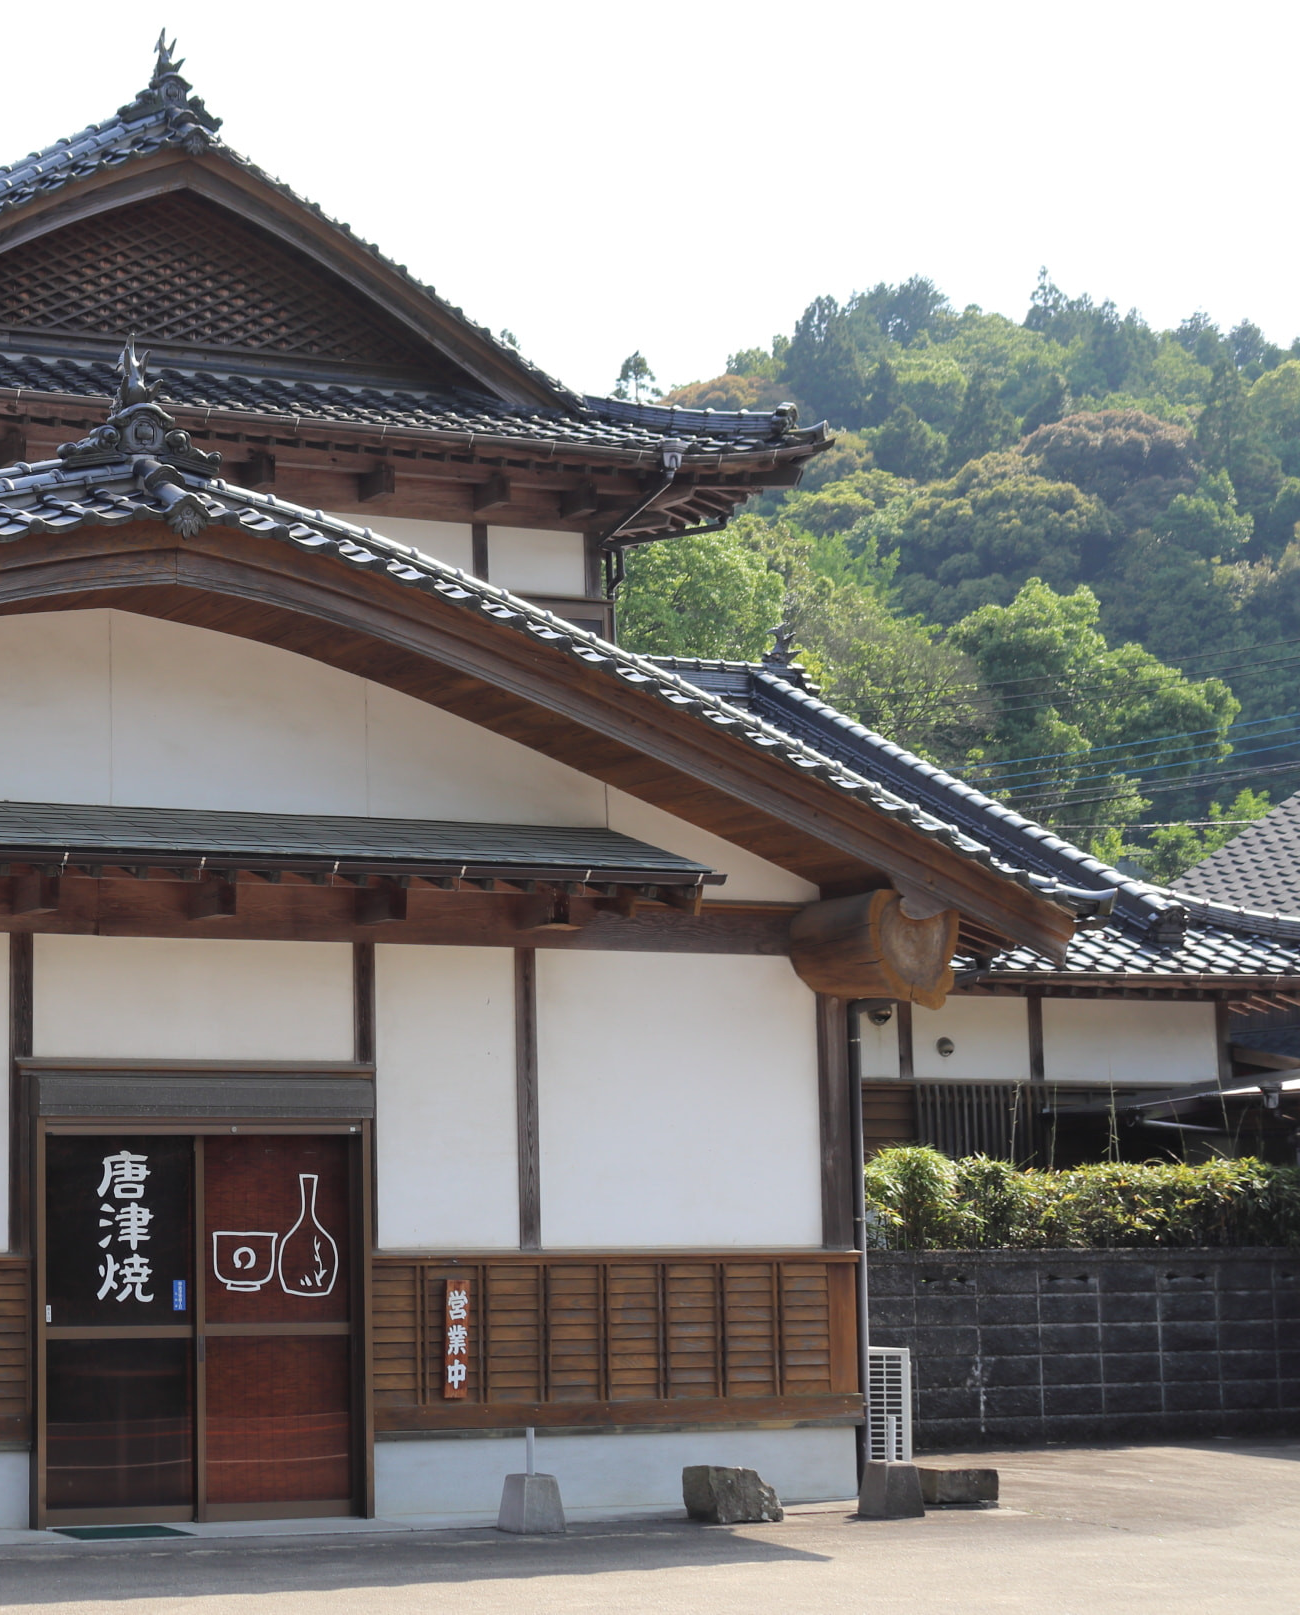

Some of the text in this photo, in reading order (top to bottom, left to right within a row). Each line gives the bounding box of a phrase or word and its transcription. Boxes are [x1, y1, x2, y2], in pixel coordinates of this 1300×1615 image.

[97, 1151, 154, 1303] 唐津焼
[447, 1289, 469, 1390] 営業中
